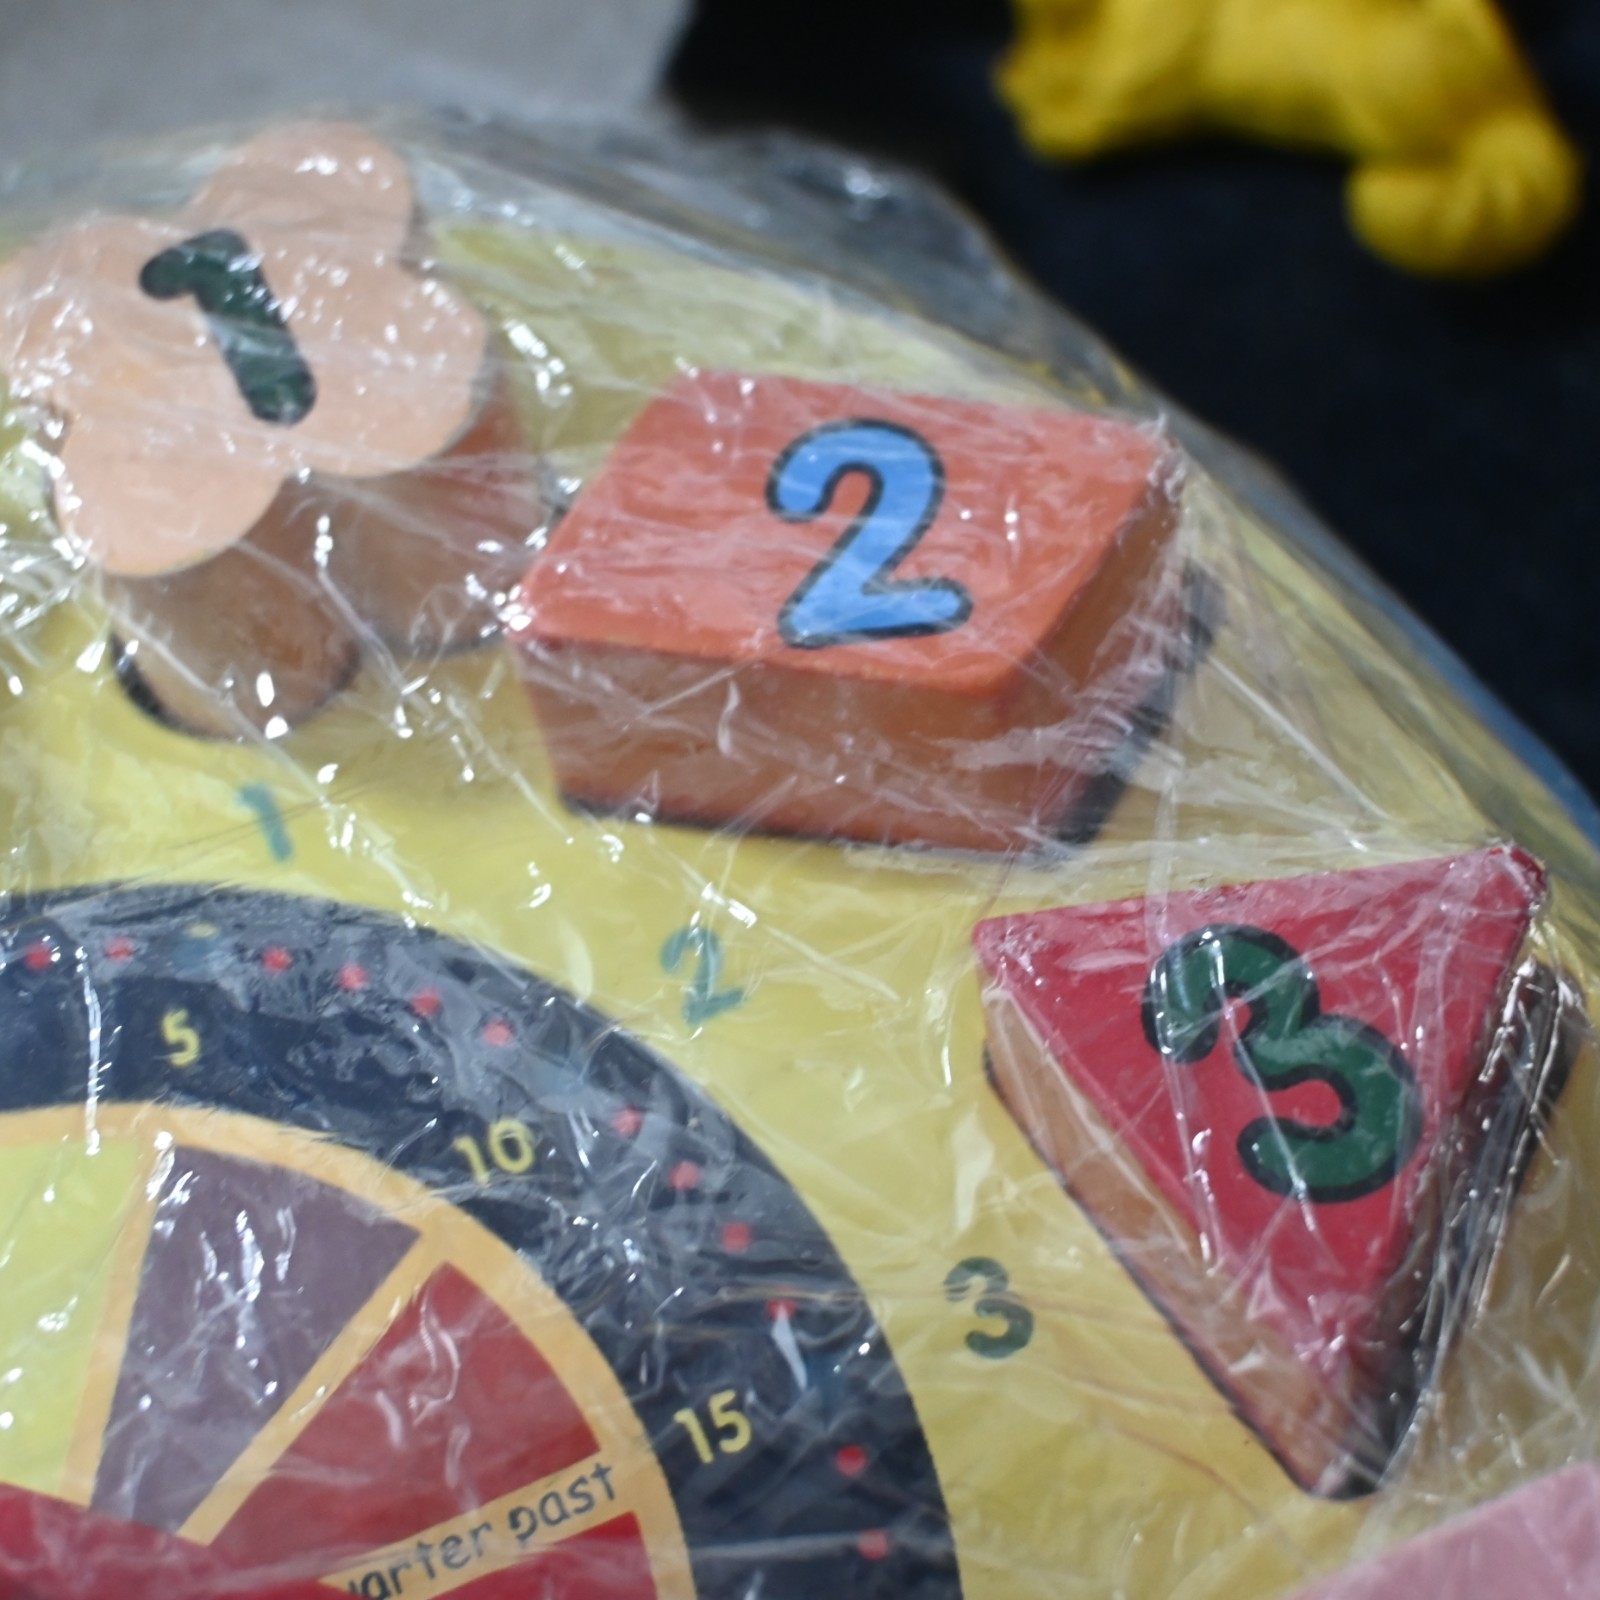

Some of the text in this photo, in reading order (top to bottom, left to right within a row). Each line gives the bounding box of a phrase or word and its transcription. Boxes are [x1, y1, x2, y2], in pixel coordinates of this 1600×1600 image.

[139, 228, 318, 427] 1
[764, 416, 971, 650] 2
[236, 784, 292, 863] 1
[659, 925, 746, 1027] 2
[161, 1009, 200, 1067] 5
[1141, 923, 1424, 1204] 3
[453, 1118, 537, 1184] 10
[944, 1256, 1034, 1360] 3
[673, 1390, 752, 1465] 15
[508, 1461, 616, 1546] past
